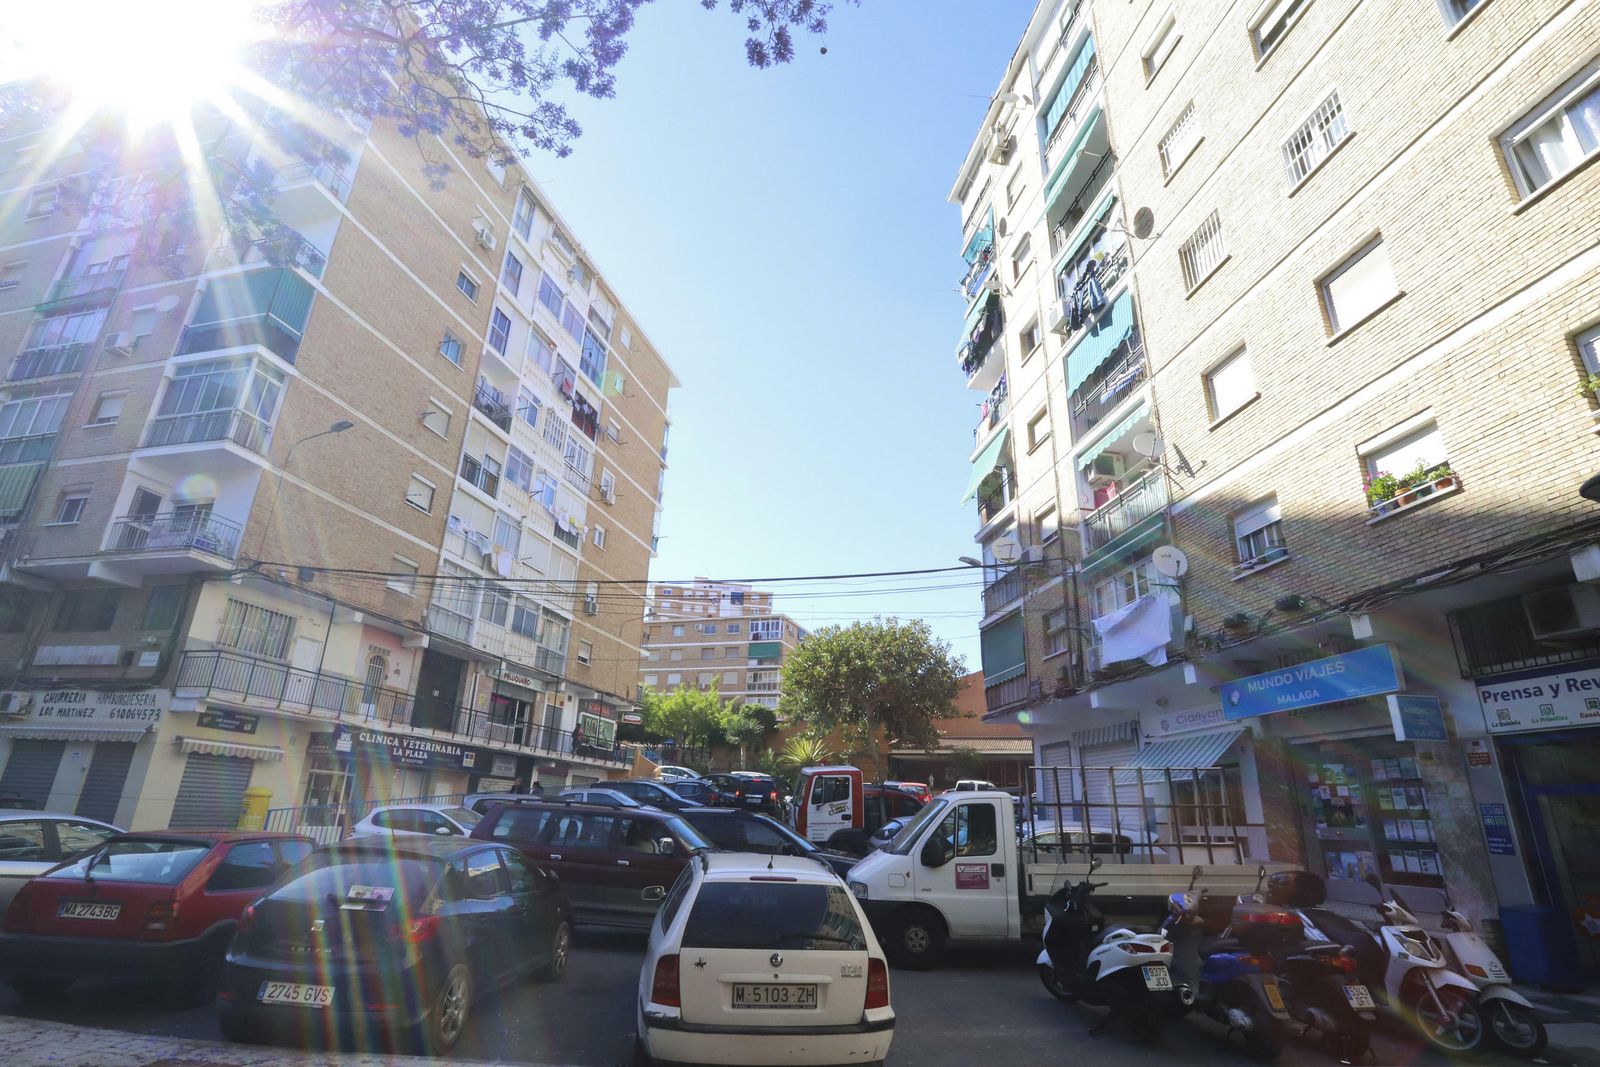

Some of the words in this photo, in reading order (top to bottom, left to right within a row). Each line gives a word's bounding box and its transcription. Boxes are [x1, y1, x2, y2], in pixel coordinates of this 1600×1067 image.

[1247, 673, 1293, 692] MUNDO
[1296, 661, 1346, 682] VIAJES
[43, 691, 87, 704] CHURRERIA
[1277, 689, 1320, 705] MALAGA
[1481, 686, 1544, 704] Prensa
[1548, 683, 1560, 699] y
[39, 706, 54, 717] LOS
[56, 707, 96, 718] MARTINEZ
[109, 708, 161, 721] 610064573
[359, 732, 399, 747] CLINICA
[403, 739, 461, 756] VETERINARIA
[393, 747, 402, 756] LA
[405, 749, 428, 759] PLAZA
[267, 984, 300, 1000] 2745
[304, 987, 330, 1003] GVS
